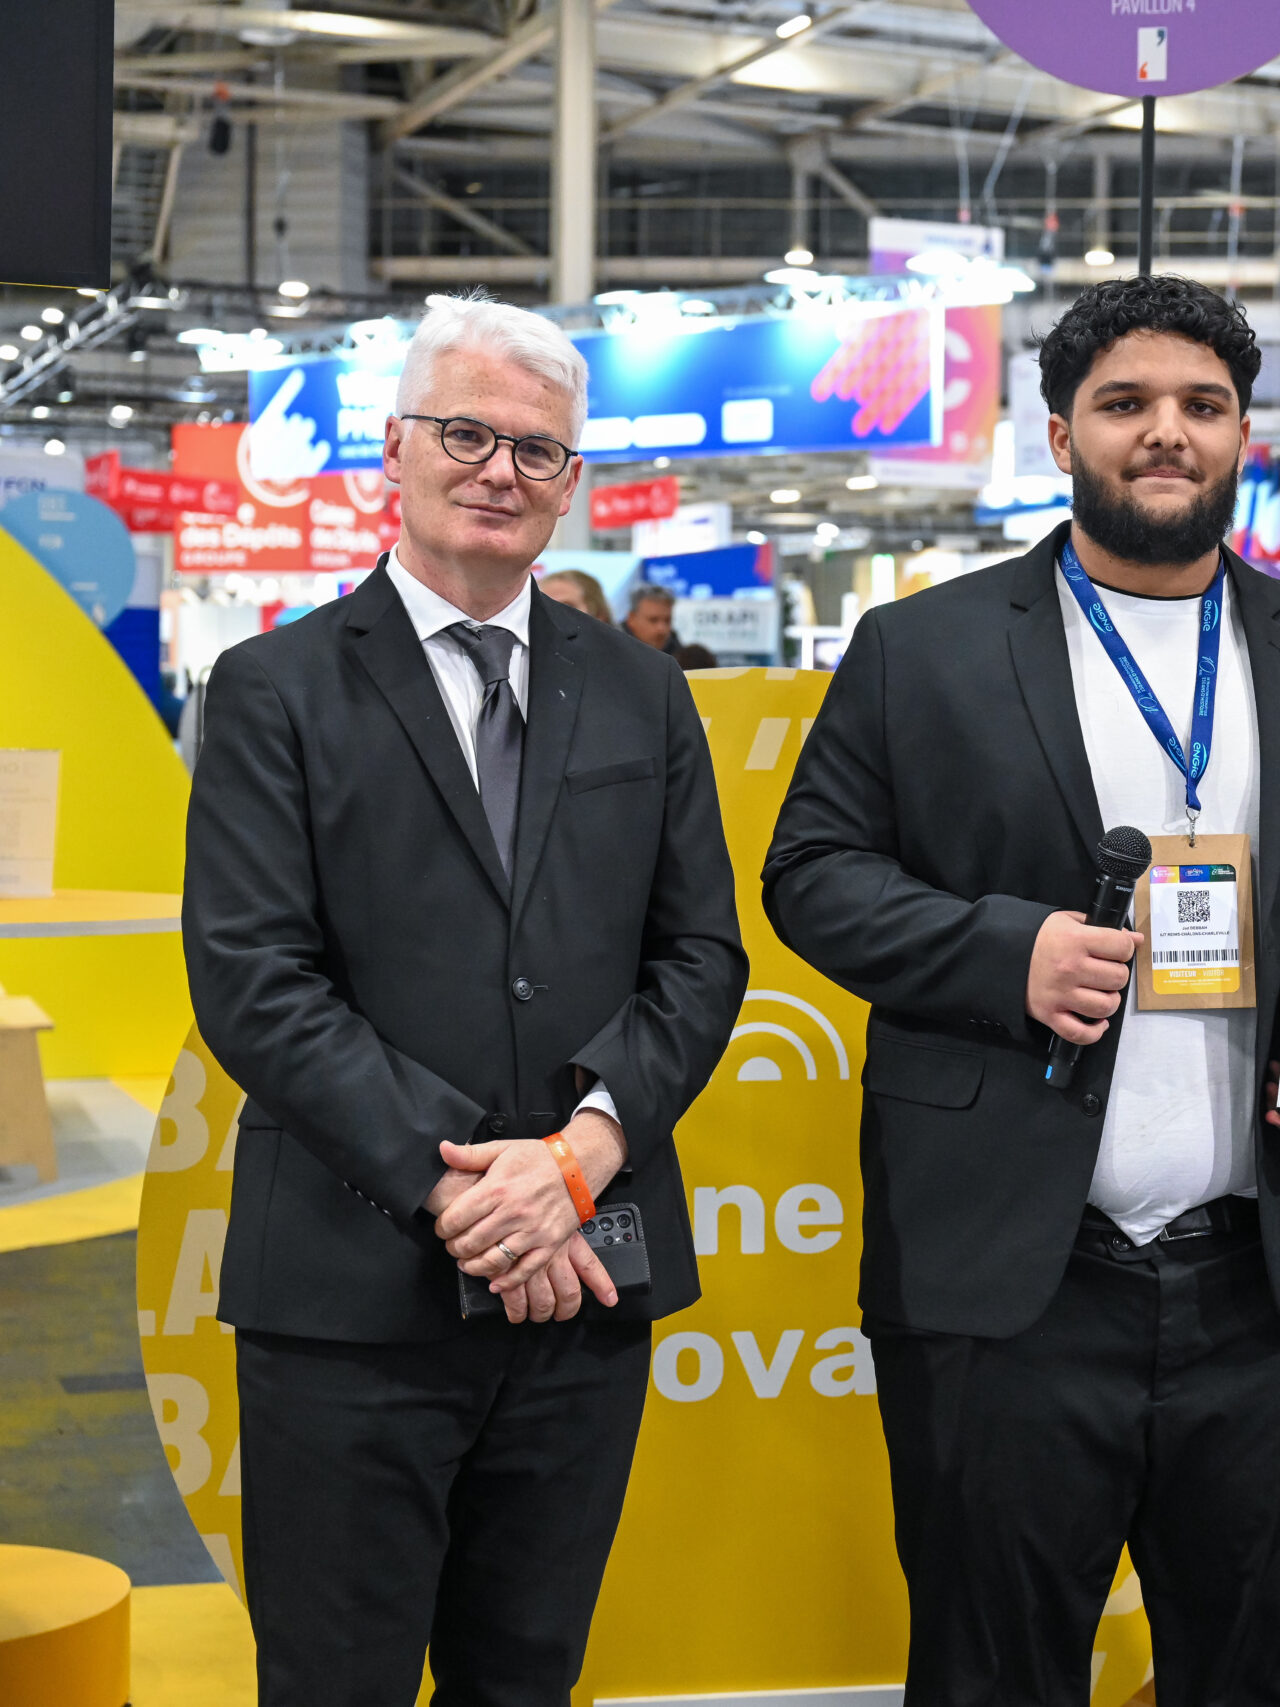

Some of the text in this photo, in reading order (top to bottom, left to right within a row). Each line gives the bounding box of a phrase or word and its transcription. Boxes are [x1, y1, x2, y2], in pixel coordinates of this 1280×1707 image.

[1111, 0, 1183, 15] PAVILLON
[694, 1183, 844, 1255] ne
[652, 1326, 877, 1402] ova
